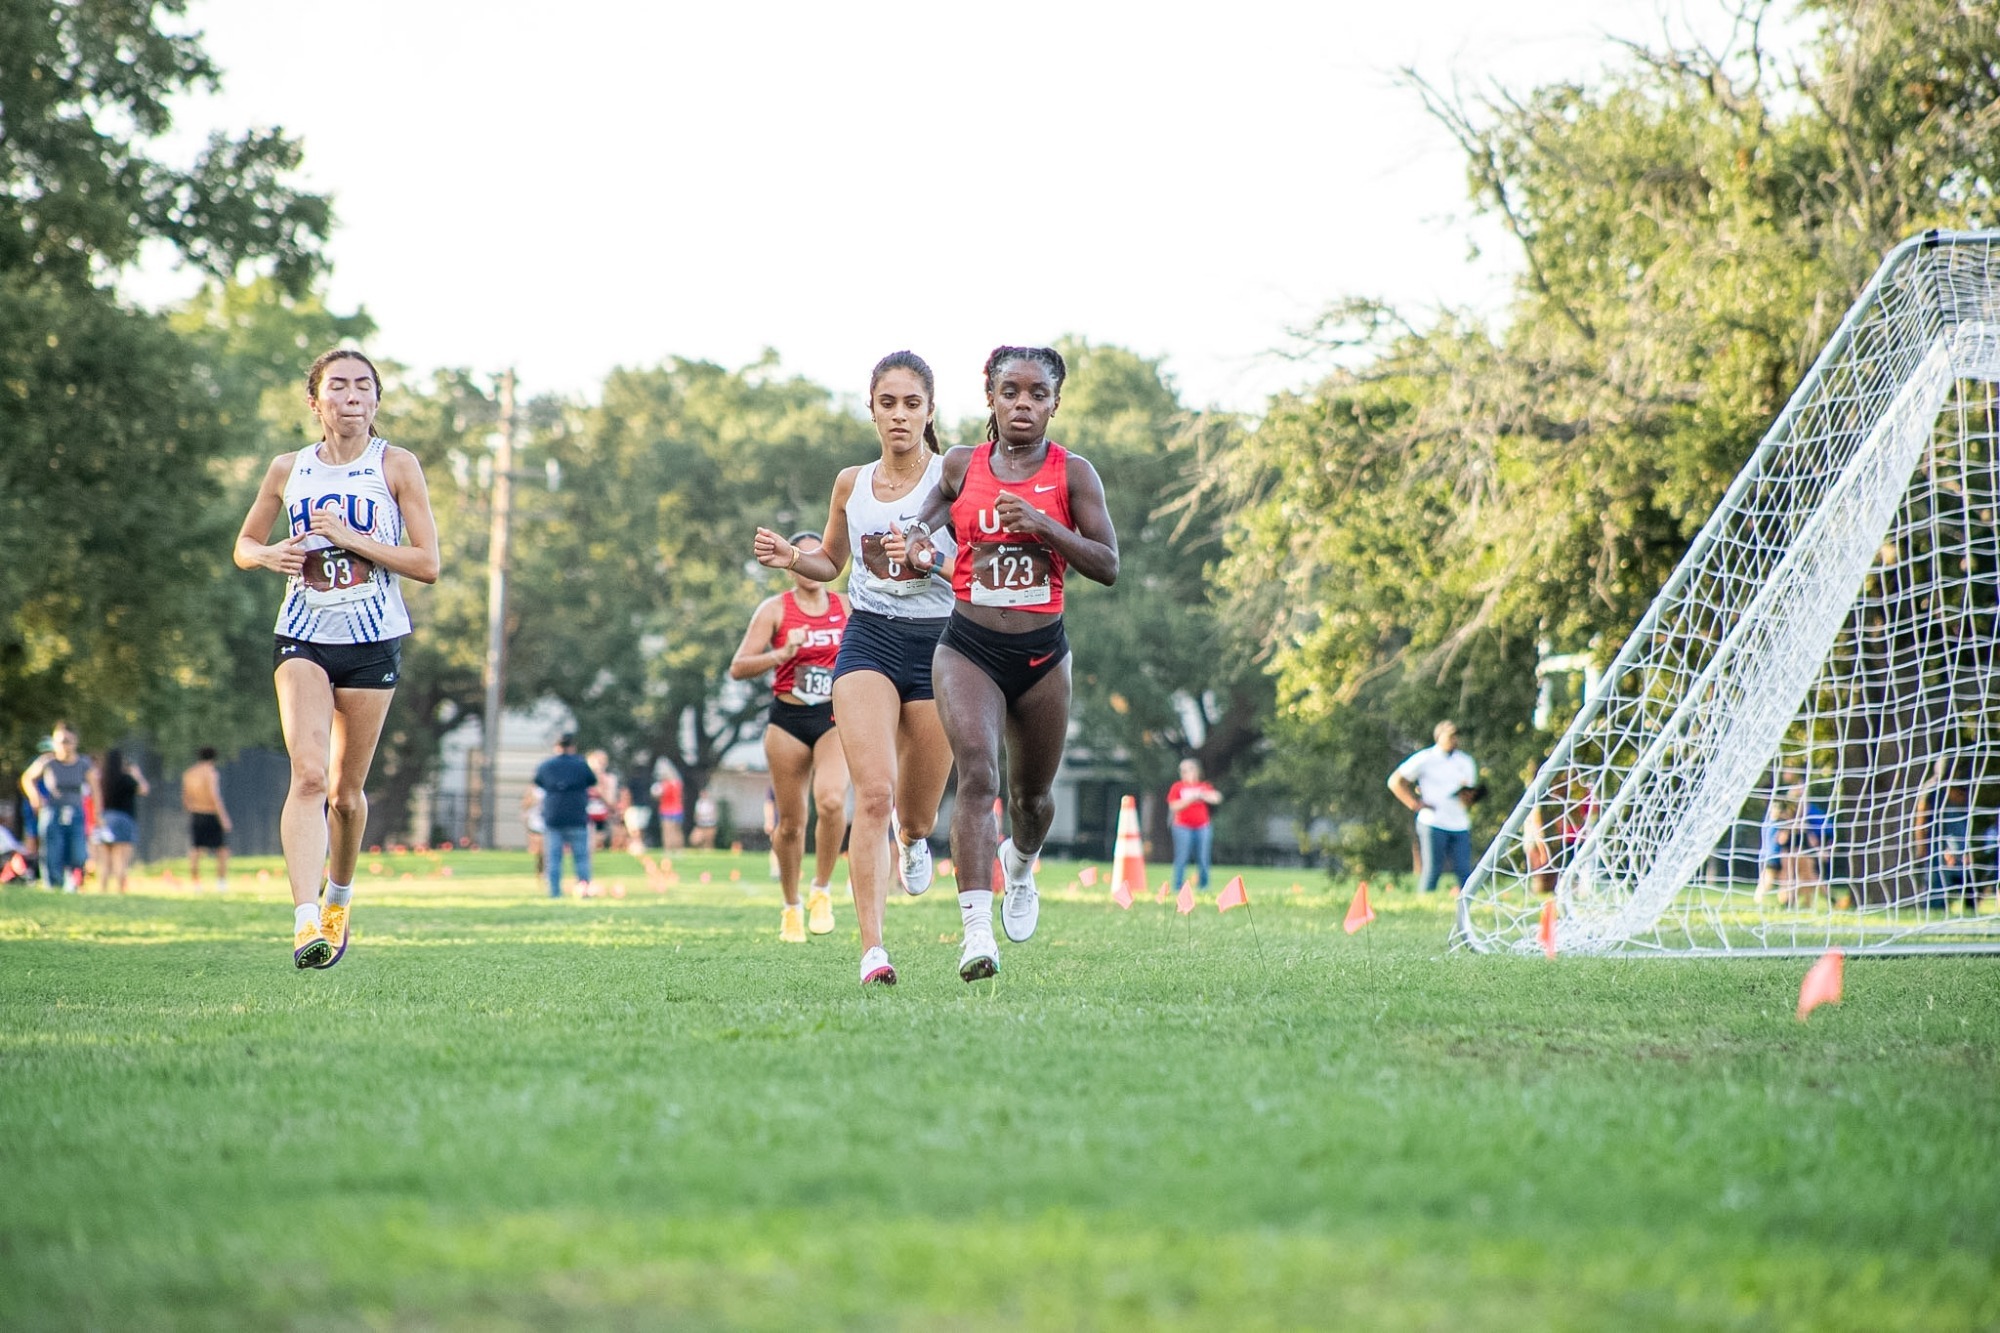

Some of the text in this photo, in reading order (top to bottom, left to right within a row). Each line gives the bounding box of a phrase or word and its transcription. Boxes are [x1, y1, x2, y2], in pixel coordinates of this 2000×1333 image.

[323, 558, 352, 588] 93
[989, 555, 1034, 587] 123
[804, 672, 833, 696] 138
